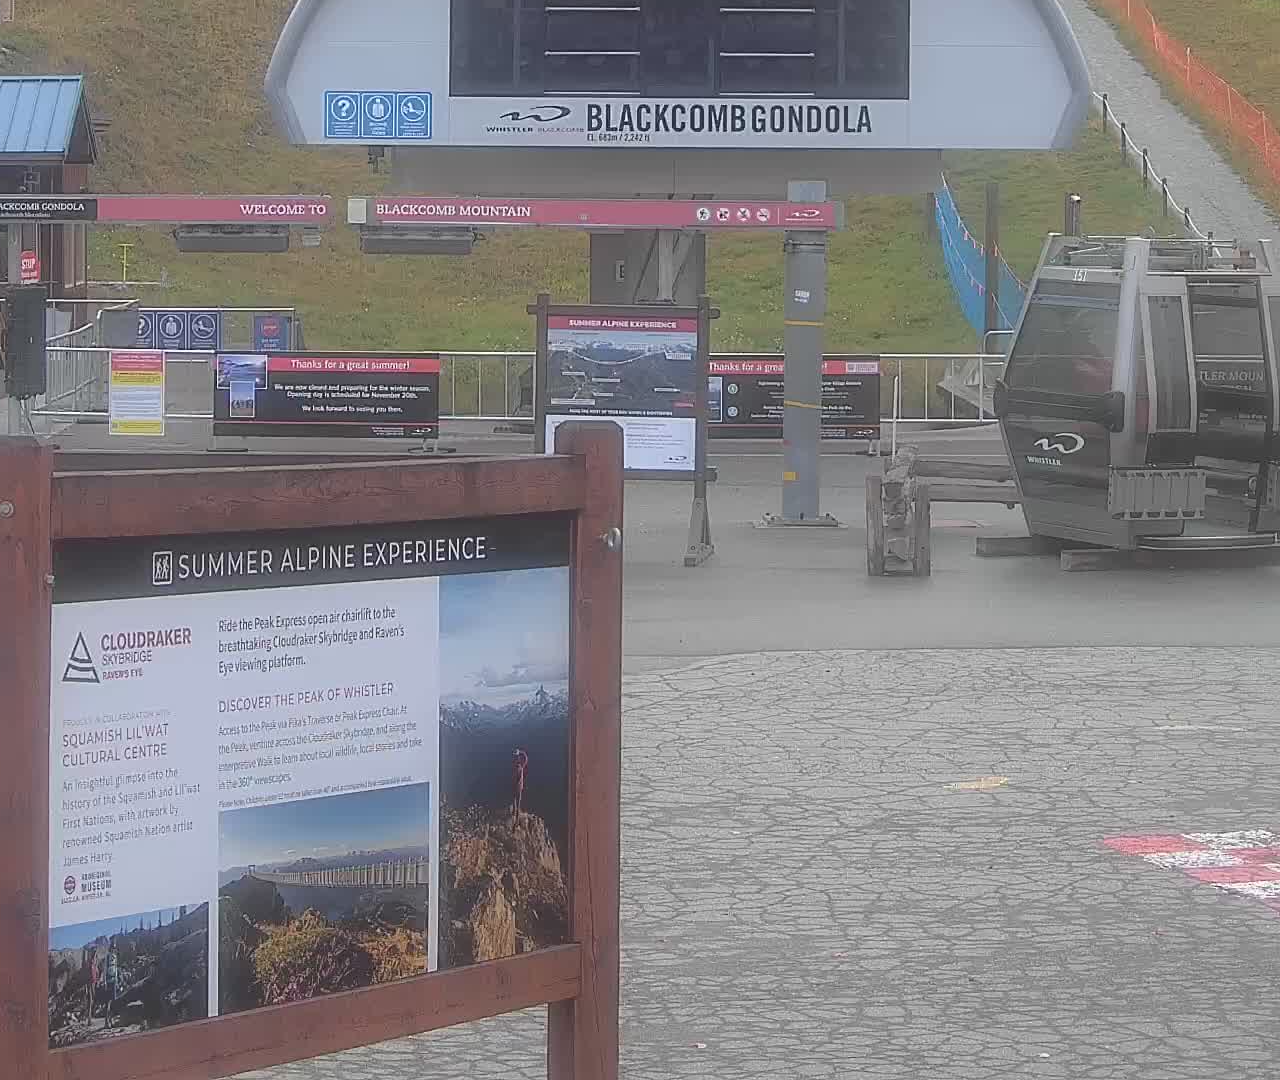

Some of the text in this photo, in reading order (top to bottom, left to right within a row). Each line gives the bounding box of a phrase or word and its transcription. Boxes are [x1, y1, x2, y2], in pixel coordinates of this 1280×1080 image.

[587, 103, 872, 133] BLACKCOMB GONDOLA
[42, 203, 84, 211] GONDOLA
[240, 204, 326, 216] WELCOME TO
[376, 204, 531, 217] BLACKCOMB MOUNTAIN
[21, 258, 35, 269] STOP
[602, 320, 629, 328] ALPINE
[630, 321, 677, 329] EXPERIENCE
[290, 360, 321, 369] Thanks
[324, 360, 336, 369] for
[347, 361, 368, 371] great
[371, 360, 410, 370] summer!
[287, 391, 311, 399] Opening
[1026, 455, 1062, 466] WHISTLER
[178, 536, 486, 580] SUMMER ALPINE EXPERIENCE
[218, 605, 396, 633] Ride the Peak Express open air chairlift to the
[101, 628, 192, 651] CLOUDRAKER
[218, 623, 405, 654] breathtaking Cloudraker Skybridge and Raven's
[102, 650, 152, 666] SKYBRIDGE
[219, 654, 306, 676] Eye viewing platform.
[102, 668, 143, 680] RAVEN'S EYE
[219, 682, 394, 713] DISCOVER THE PEAK OF WHISTLER
[62, 723, 168, 748] SQUAMISH LIL'WAT
[219, 744, 230, 755] the
[275, 736, 295, 748] across
[296, 733, 307, 745] the
[376, 724, 388, 734] and
[406, 721, 417, 731] the
[62, 743, 167, 767] CULTURAL CENTRE
[62, 768, 178, 792] An insightful glimpse into the
[62, 799, 91, 810] history
[93, 797, 102, 806] of
[103, 795, 116, 805] the
[119, 788, 157, 804] Squamish
[158, 787, 172, 798] and
[62, 804, 179, 829] First Nations, with artwork by
[62, 820, 193, 848] renowned Squamish Nation artist
[64, 852, 112, 866] James Harry
[81, 880, 112, 892] MUSEUM
